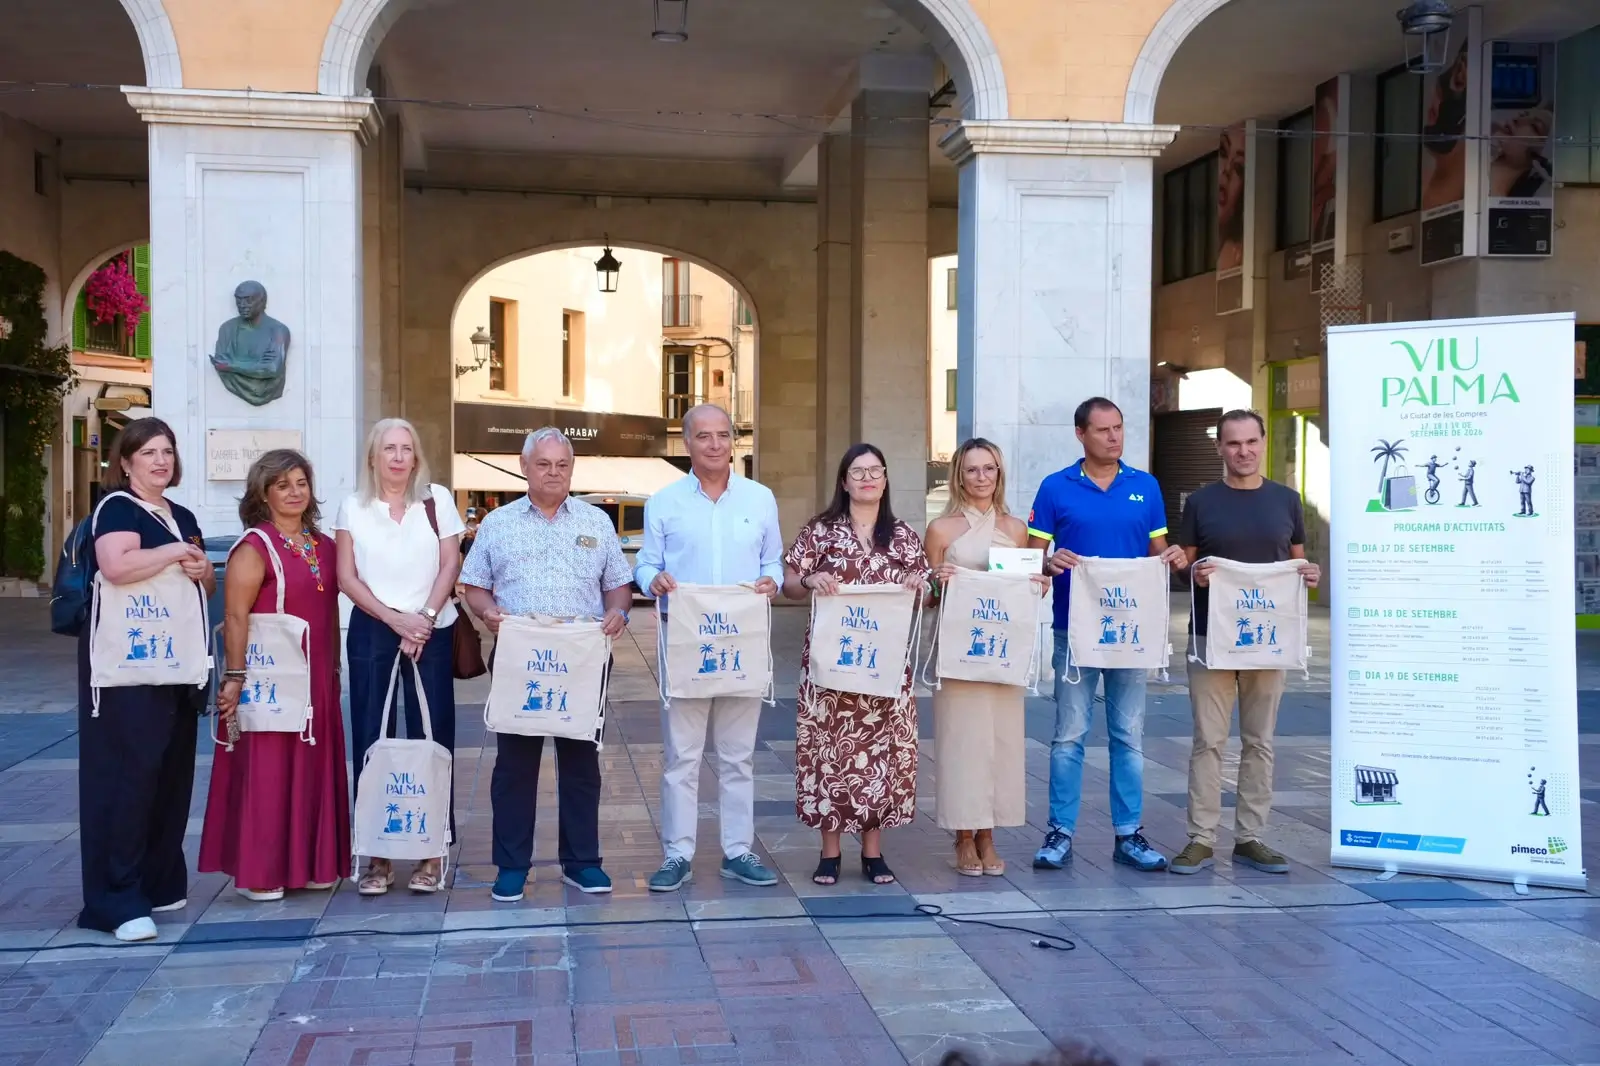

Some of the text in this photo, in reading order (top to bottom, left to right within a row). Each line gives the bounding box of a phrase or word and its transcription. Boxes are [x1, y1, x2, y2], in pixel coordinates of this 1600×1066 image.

[1390, 337, 1478, 371] VIU
[1382, 372, 1520, 407] PALMA
[564, 427, 598, 437] ARABAY
[1394, 523, 1505, 532] PROGRAMA D'ACTIVITATS
[1362, 544, 1455, 552] DIA 17 DE SETEMBRE
[1101, 586, 1126, 598] VIU
[1238, 588, 1265, 599] VIU
[128, 595, 156, 607] VIU
[976, 597, 1000, 610] VIU
[1100, 598, 1137, 608] PALMA
[1236, 600, 1275, 609] PALMA
[126, 607, 170, 618] PALMA
[845, 605, 870, 618] VIU
[972, 609, 1009, 621] PALMA
[1364, 609, 1457, 618] DIA 18 DE SETEMBRE
[701, 613, 727, 624] VIU
[841, 616, 878, 631] PALMA
[699, 624, 738, 635] PALMA
[531, 649, 558, 661] VIU
[527, 661, 568, 673] PALMA
[1365, 671, 1459, 682] DIA 19 DE SETEMBRE
[389, 773, 415, 784] VIU
[386, 784, 425, 794] PALMA
[1511, 844, 1547, 855] pimeco
